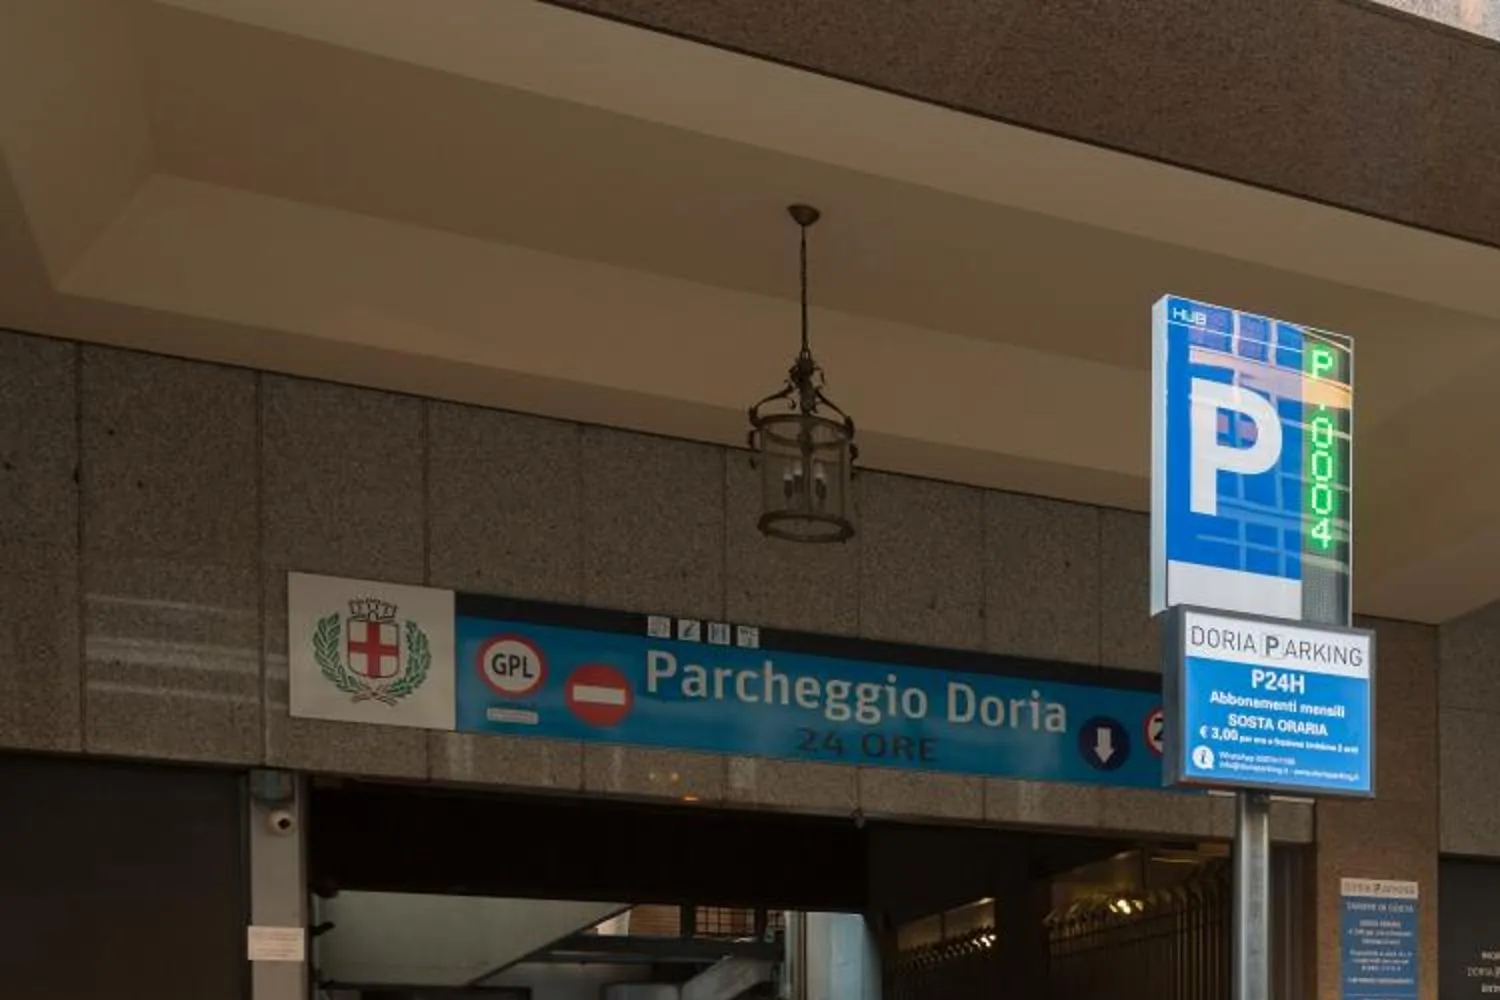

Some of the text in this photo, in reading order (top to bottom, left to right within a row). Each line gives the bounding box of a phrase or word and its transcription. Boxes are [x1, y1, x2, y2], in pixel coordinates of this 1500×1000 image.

[1172, 307, 1207, 326] HUB
[1189, 377, 1283, 517] P
[1191, 625, 1364, 668] DORIA PARKING
[491, 652, 534, 679] GPL
[646, 649, 1068, 734] Parcheggio Doria
[1251, 669, 1305, 694] P24H
[1210, 690, 1345, 718] Abbonamenti mensili
[1228, 713, 1328, 737] SOSTA ORARIA
[793, 728, 940, 762] 24 ORE
